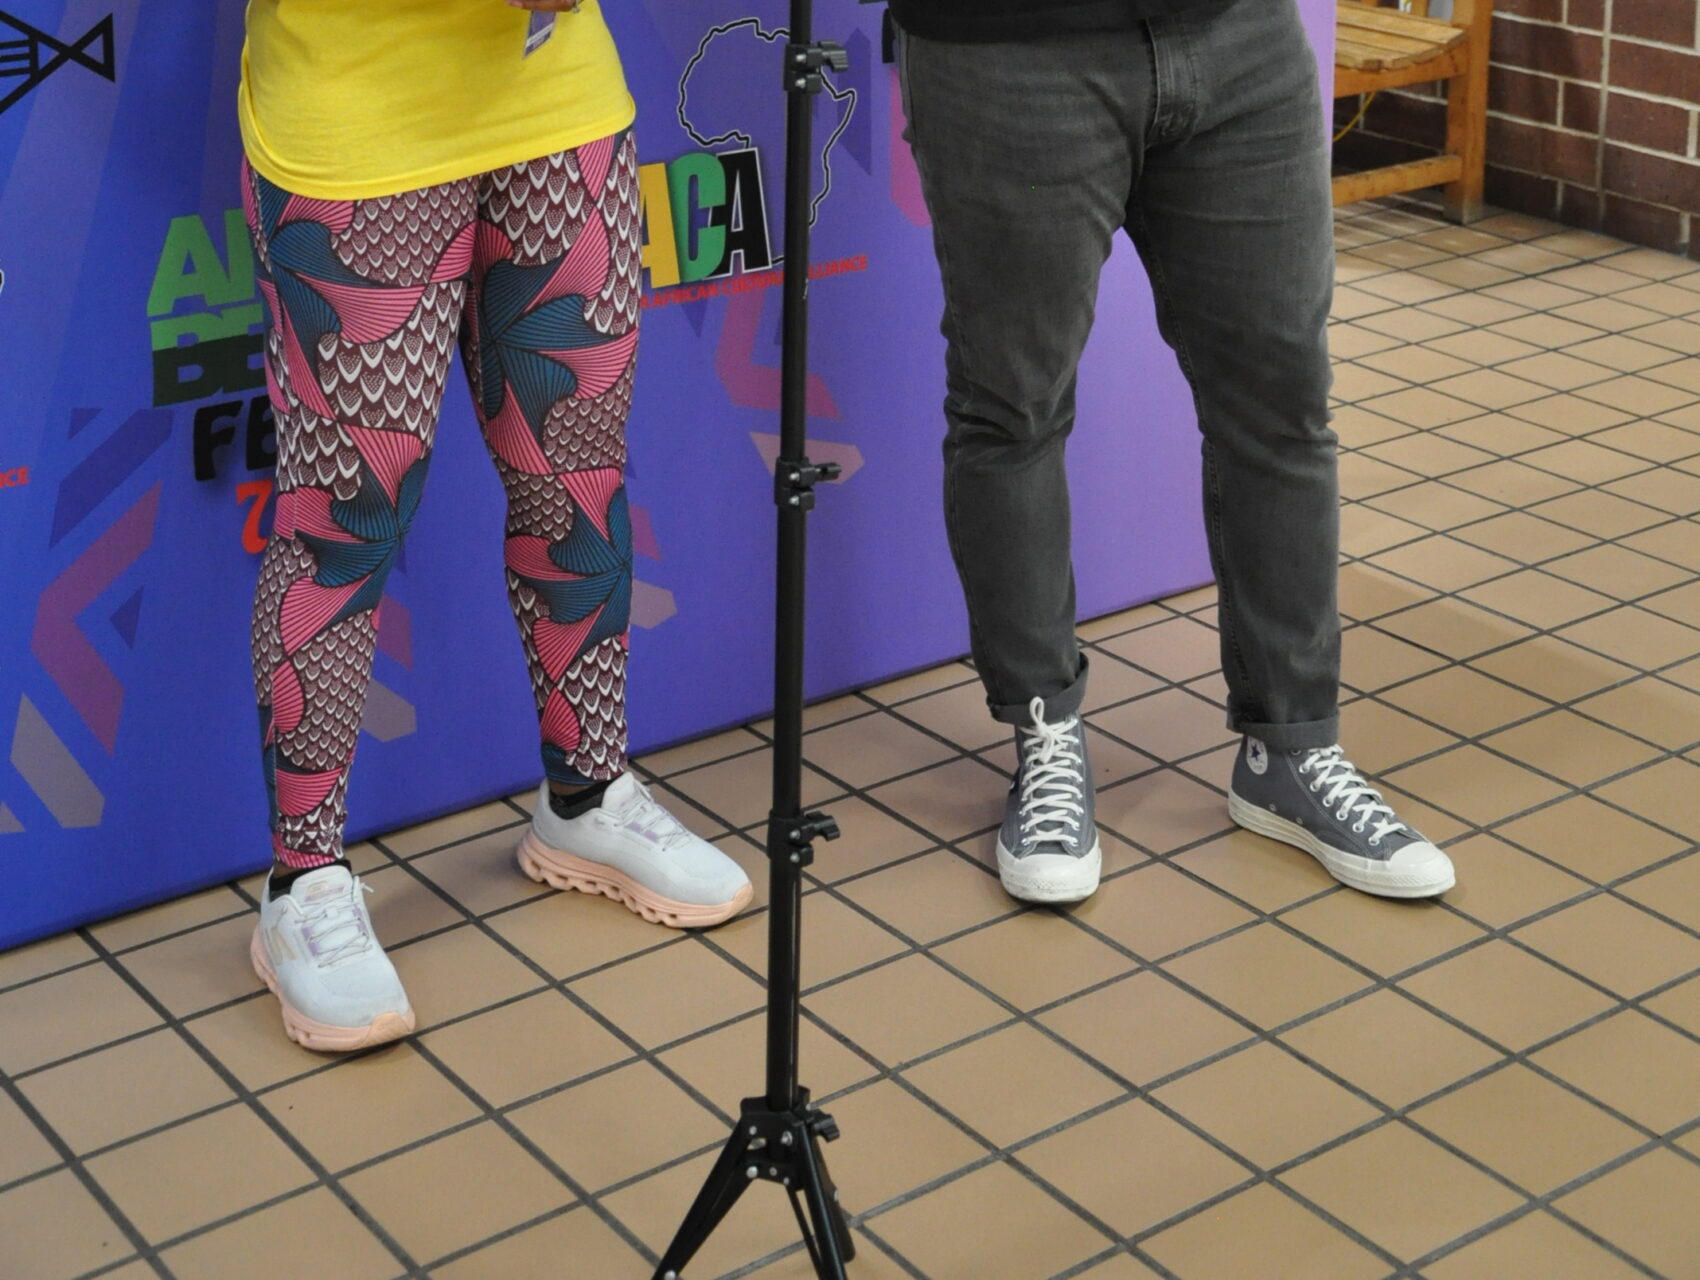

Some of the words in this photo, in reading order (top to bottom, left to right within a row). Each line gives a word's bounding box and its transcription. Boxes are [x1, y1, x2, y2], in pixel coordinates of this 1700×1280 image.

[640, 147, 772, 289] ACA
[653, 285, 719, 308] AFRICAN
[721, 270, 783, 295] CULTURA
[808, 254, 869, 281] LLIANCE
